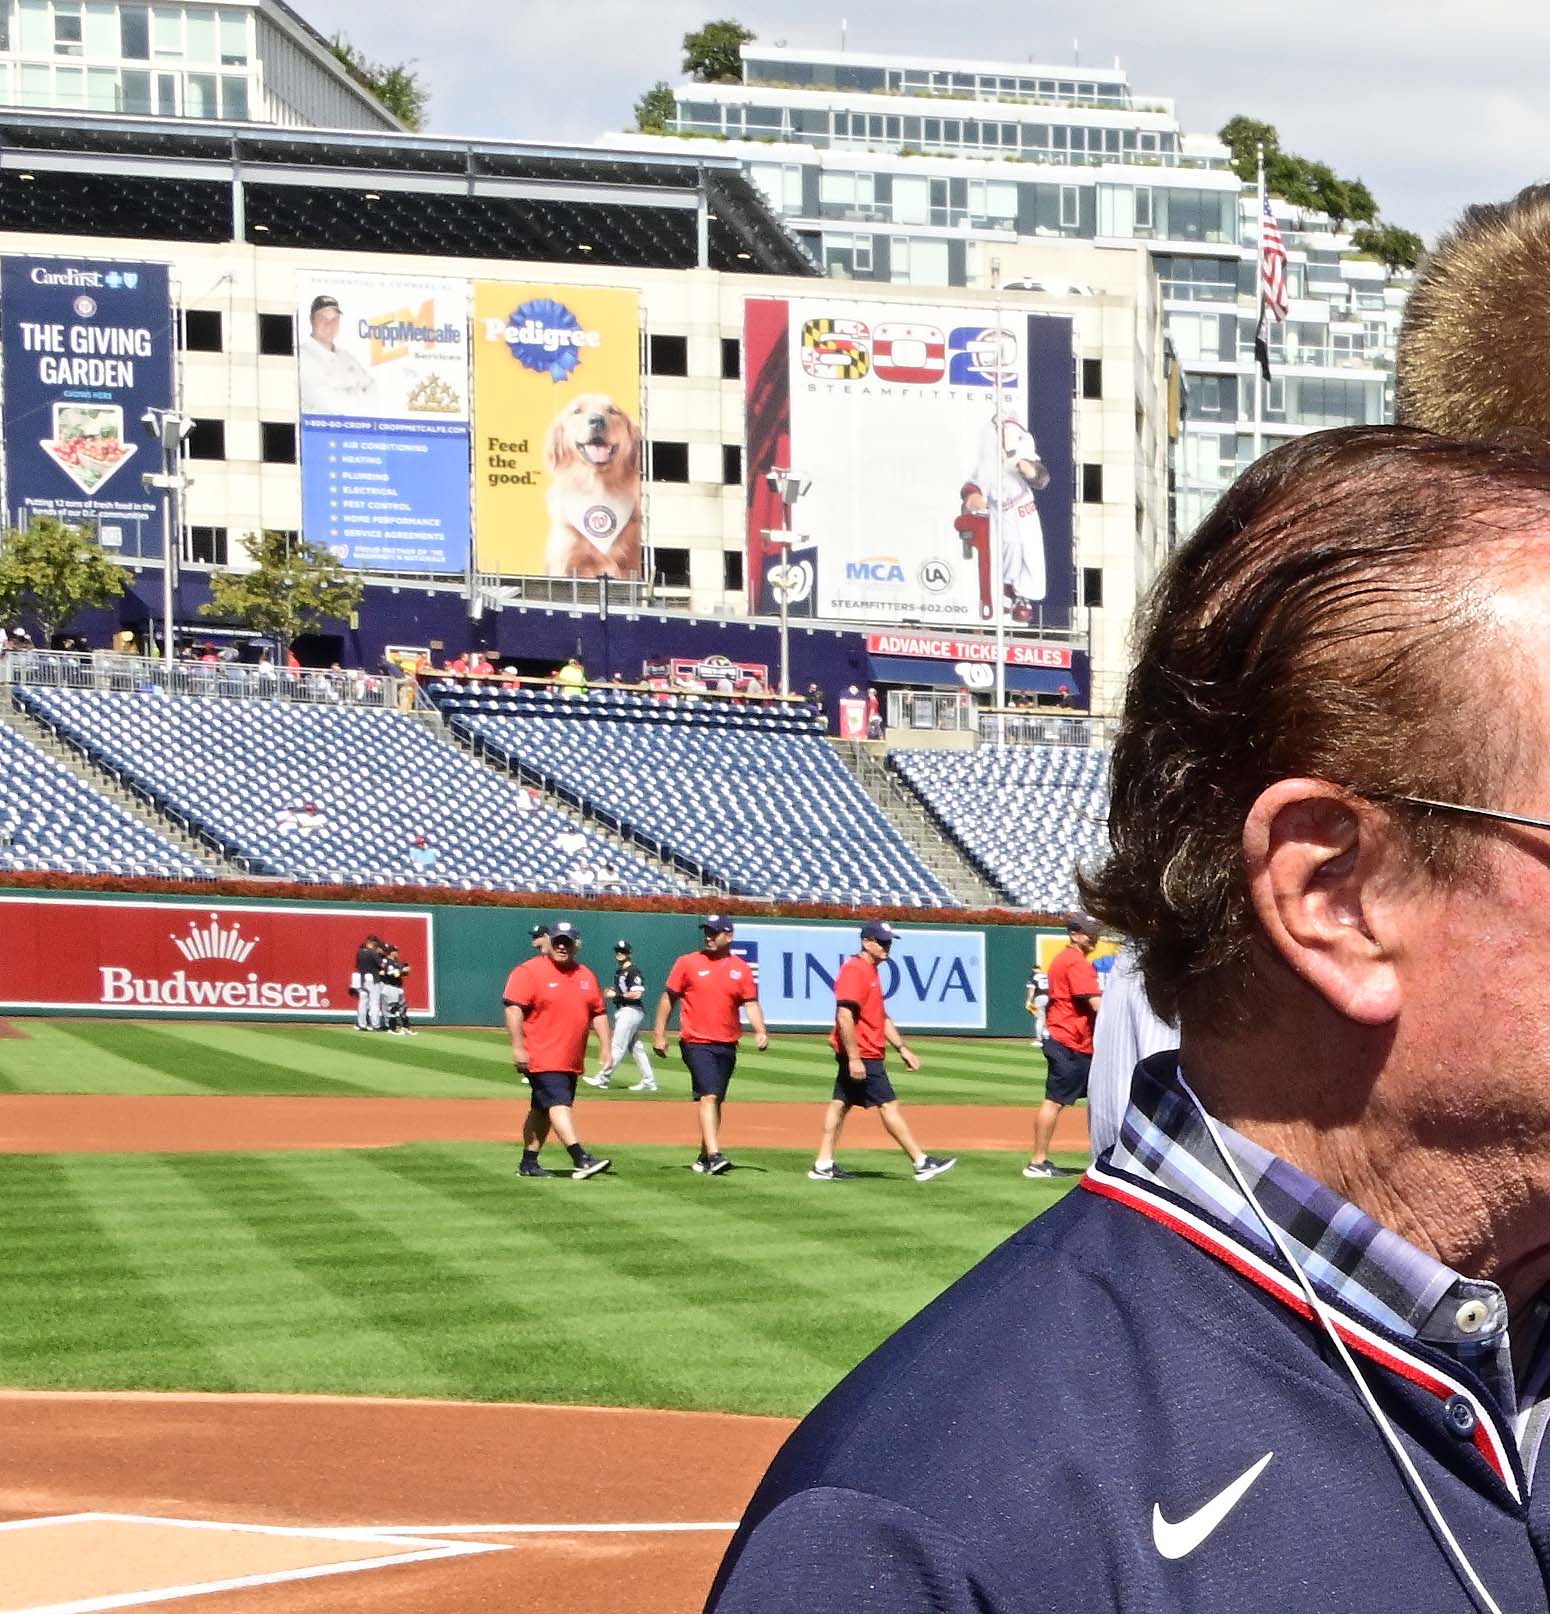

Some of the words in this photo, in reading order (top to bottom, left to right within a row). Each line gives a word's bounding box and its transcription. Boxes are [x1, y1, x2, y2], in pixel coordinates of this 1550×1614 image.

[20, 323, 65, 352] THE
[70, 326, 152, 357] GIVING
[484, 318, 600, 351] Pedigree
[801, 318, 1019, 389] 602
[40, 356, 134, 388] GARDEN
[807, 383, 1013, 403] STEAMFITTERS
[488, 437, 528, 453] Feed
[489, 455, 516, 469] the
[489, 470, 537, 486] good.
[845, 562, 905, 583] MCA
[878, 636, 950, 657] ADVANCE
[1014, 647, 1063, 665] SALES
[99, 966, 327, 1008] Budweiser
